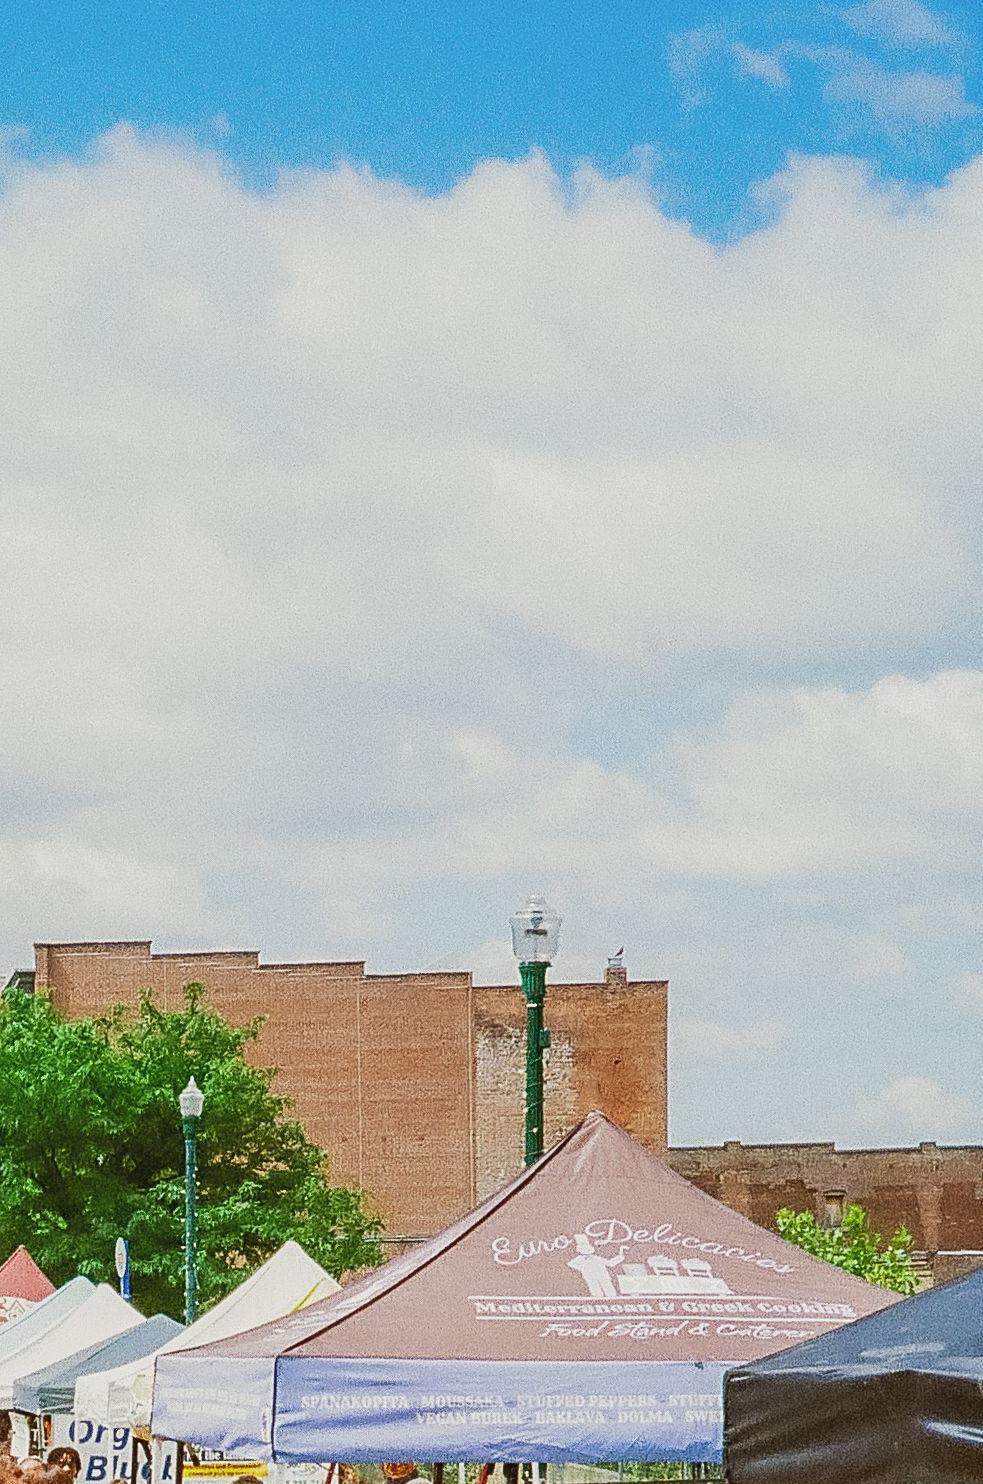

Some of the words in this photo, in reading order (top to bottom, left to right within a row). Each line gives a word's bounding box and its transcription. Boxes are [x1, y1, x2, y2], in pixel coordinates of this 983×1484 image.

[491, 1234, 573, 1266] Euro
[584, 1218, 795, 1274] Delicacies
[473, 1302, 655, 1314] Mediterranean
[681, 1301, 755, 1313] Greek
[756, 1301, 858, 1318] Cooking
[538, 1320, 611, 1338] Food
[606, 1319, 690, 1339] Stand
[687, 1322, 711, 1337] &
[300, 1394, 410, 1409] SPANAKOPITA
[420, 1394, 505, 1408] MOUSSAKA
[516, 1393, 585, 1408] STUFFED
[587, 1394, 657, 1408] PEPPERS
[416, 1412, 467, 1425] VEGAN
[534, 1410, 606, 1425] BAKLAVA
[617, 1409, 674, 1424] DOLMA
